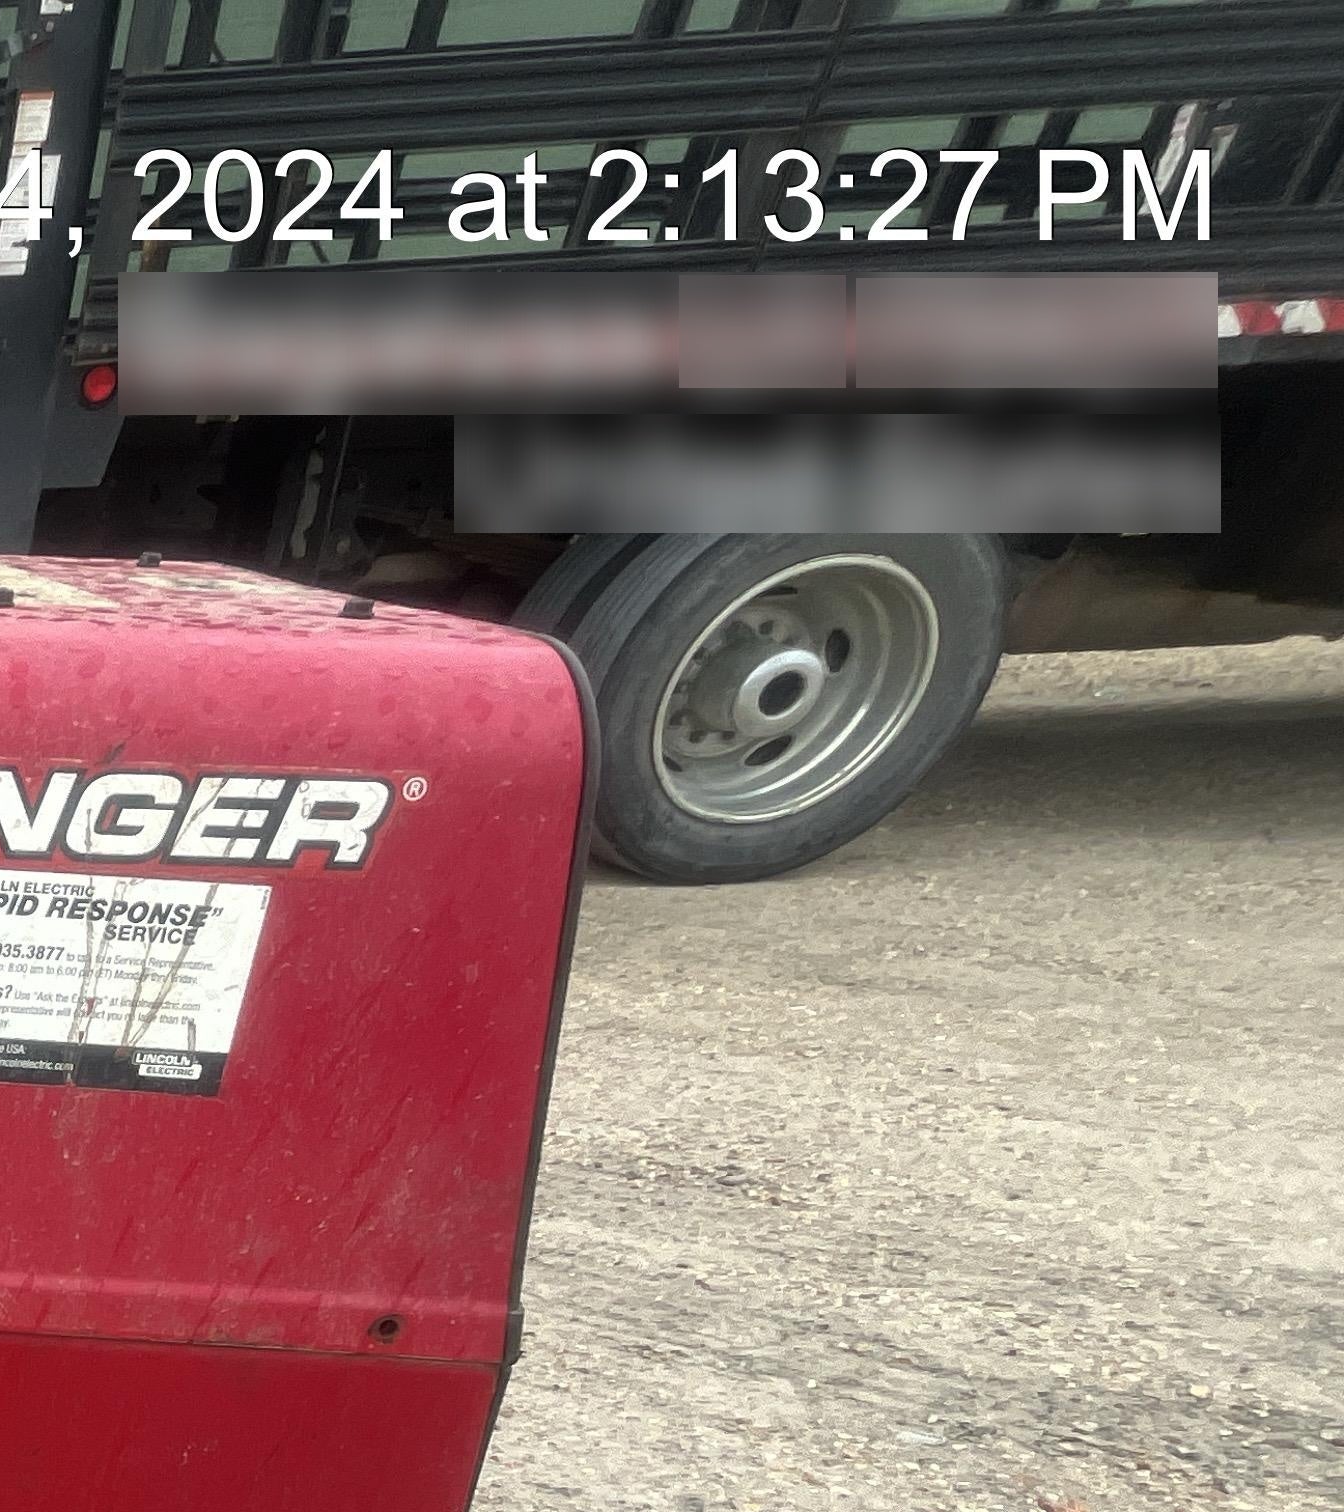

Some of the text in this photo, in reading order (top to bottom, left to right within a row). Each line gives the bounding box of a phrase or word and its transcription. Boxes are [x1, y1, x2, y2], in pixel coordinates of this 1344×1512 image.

[23, 883, 96, 898] ELECTRIC
[102, 924, 198, 946] SERVICE
[66, 952, 76, 962] to
[113, 954, 147, 967] Service
[45, 965, 55, 975] to
[14, 989, 31, 1001] Use
[55, 992, 70, 1003] the
[135, 1052, 191, 1066] LINCOLN
[145, 1065, 195, 1077] ELECTRIC
